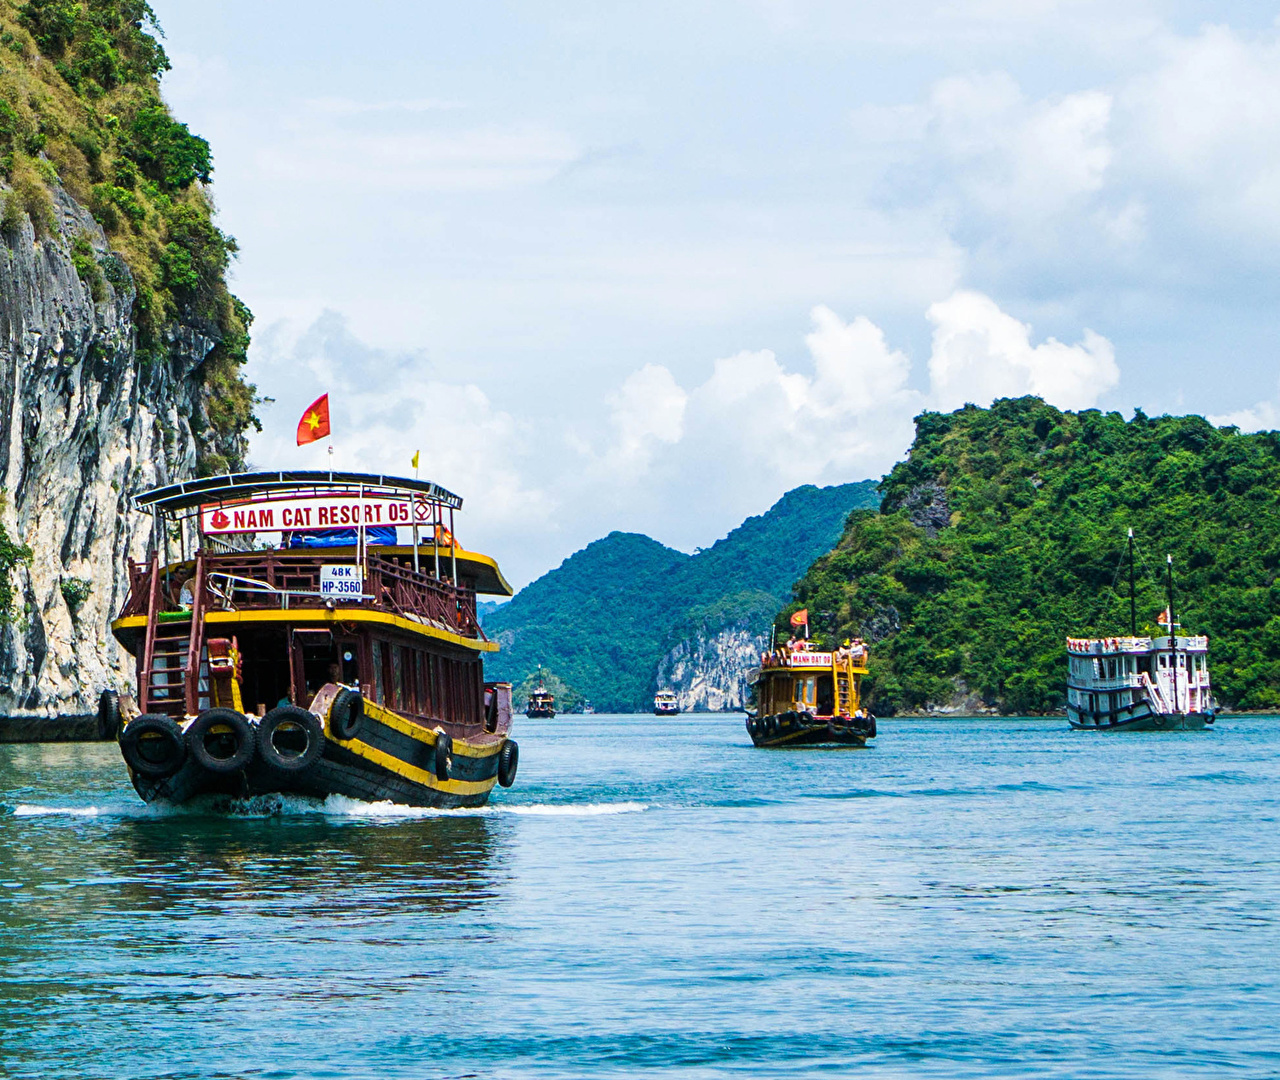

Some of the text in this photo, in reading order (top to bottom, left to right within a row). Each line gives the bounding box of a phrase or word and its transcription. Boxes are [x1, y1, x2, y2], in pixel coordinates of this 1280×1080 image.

[234, 503, 409, 529] NAM CAT RESORT 05
[322, 581, 361, 593] HP-3560
